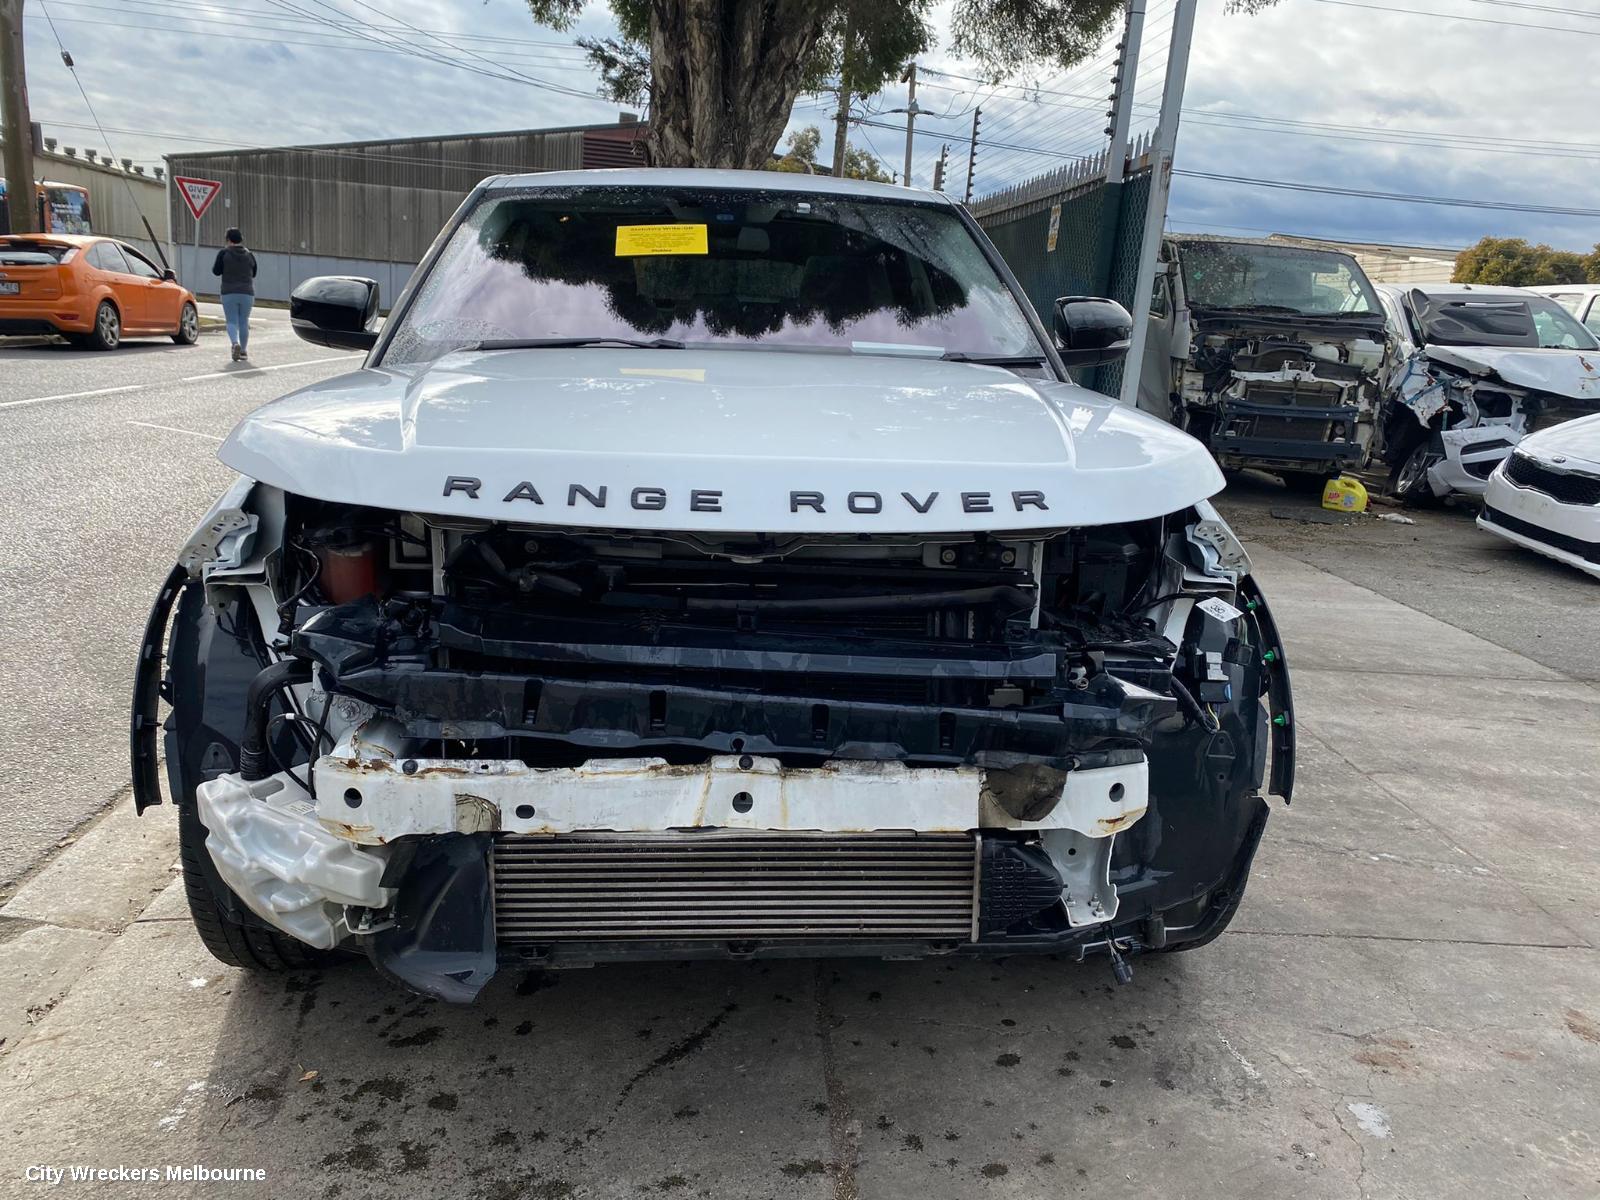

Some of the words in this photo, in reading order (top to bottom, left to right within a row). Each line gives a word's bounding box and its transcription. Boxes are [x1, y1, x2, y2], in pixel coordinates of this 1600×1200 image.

[188, 185, 208, 194] GIVE
[443, 475, 723, 512] RANGE
[790, 490, 1050, 514] ROVER
